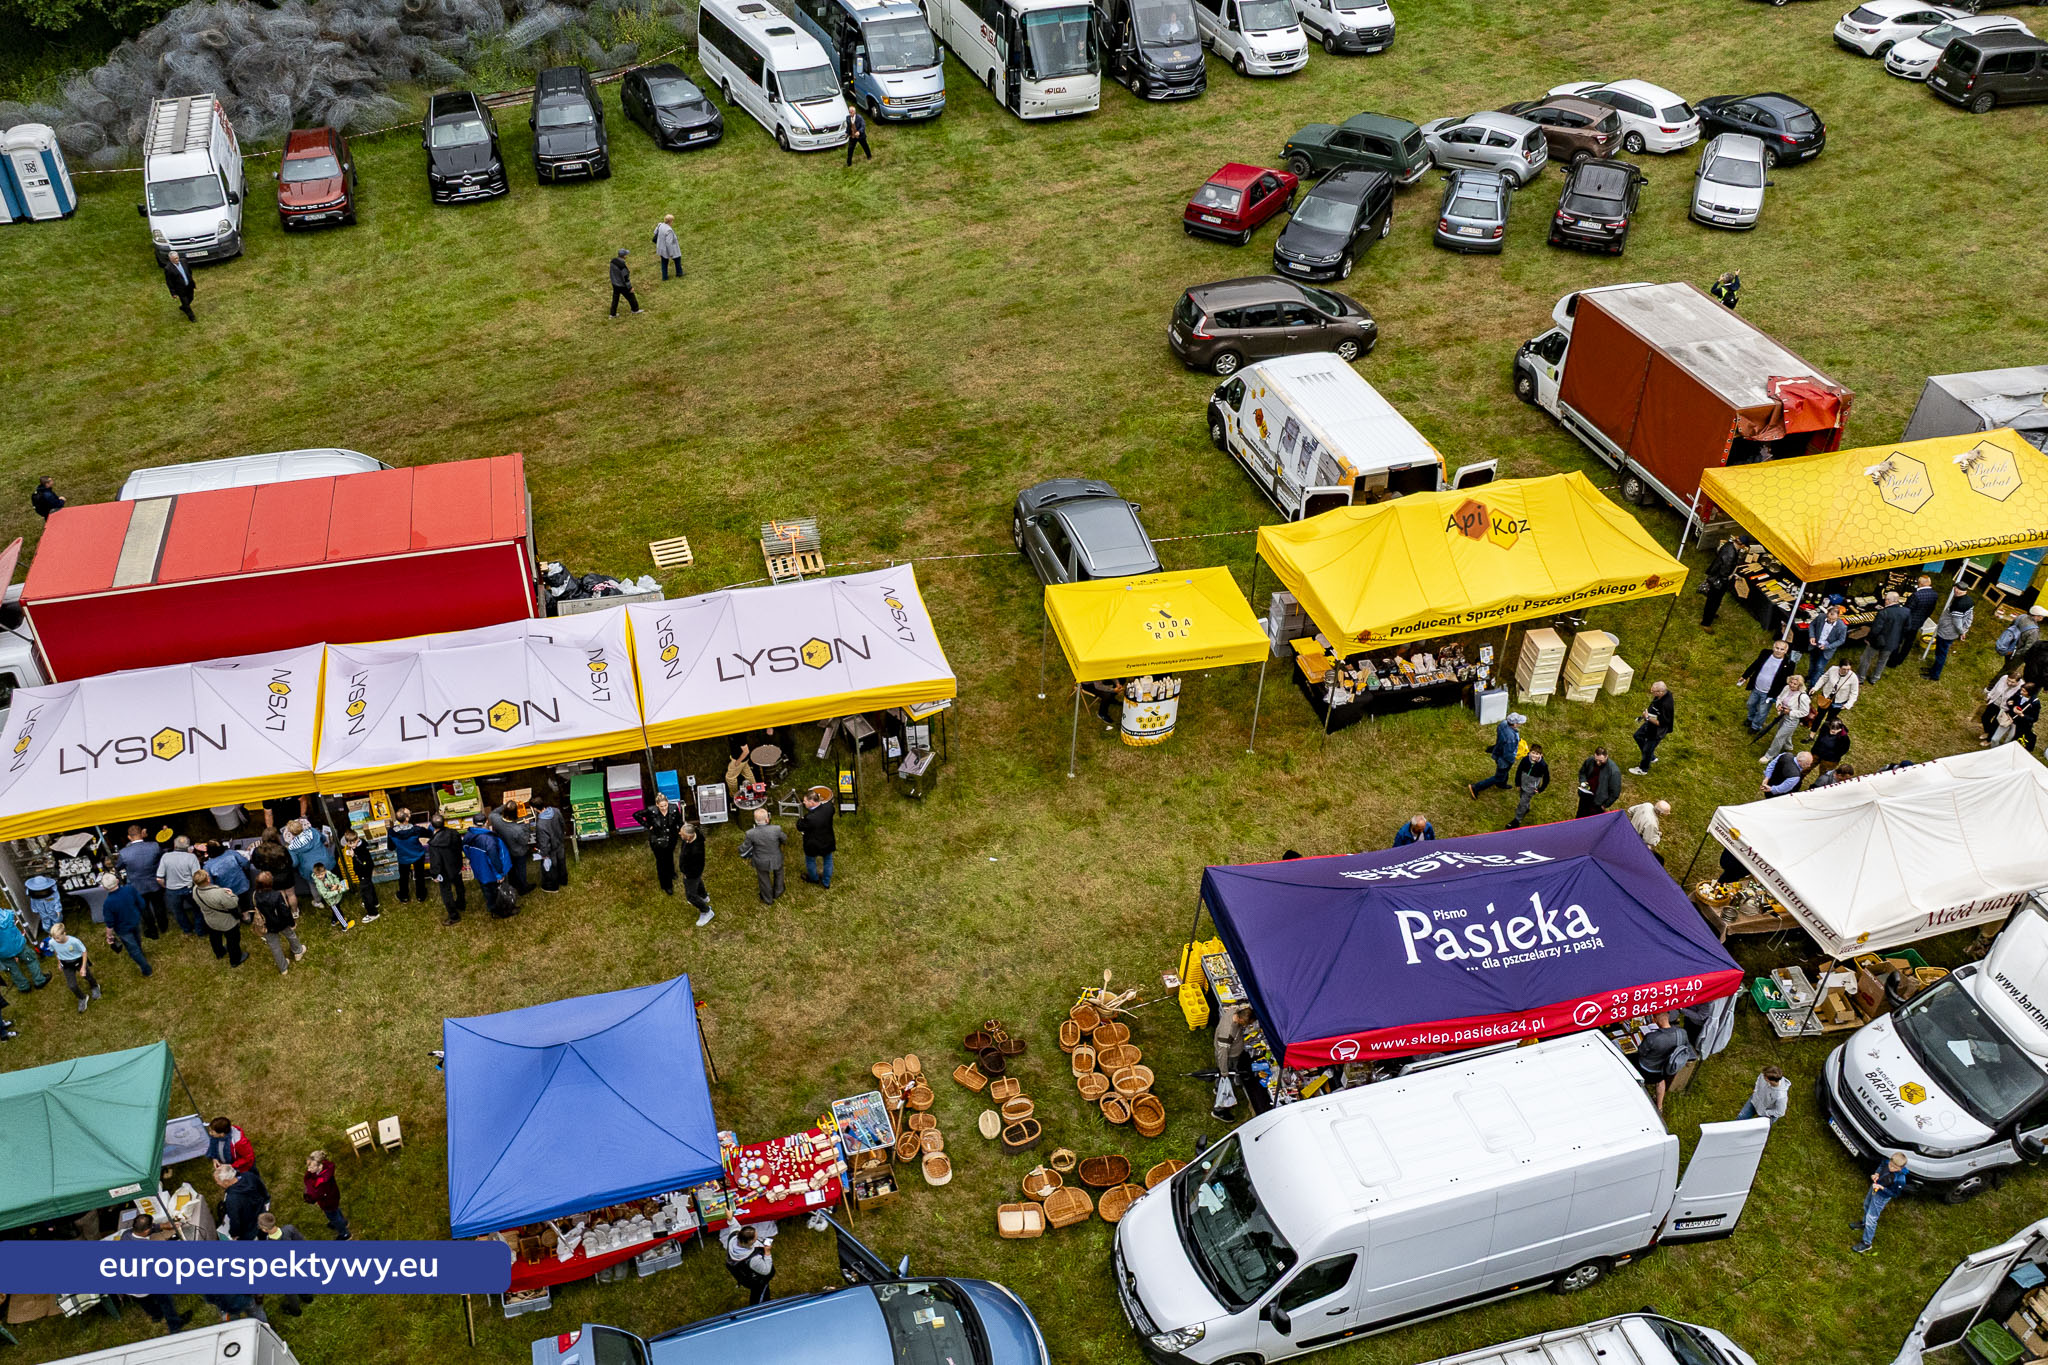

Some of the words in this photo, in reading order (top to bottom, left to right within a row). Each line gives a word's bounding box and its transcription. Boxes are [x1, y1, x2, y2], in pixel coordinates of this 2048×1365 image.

[2027, 528, 2048, 542] BA
[1146, 618, 1191, 631] SUDA
[1390, 614, 1462, 637] Producent
[1466, 604, 1519, 623] Sprzętu
[1523, 583, 1637, 610] Pszczelarskiego
[1154, 629, 1187, 640] ROL
[716, 635, 871, 682] LYSON
[400, 697, 561, 742] LYSON
[1138, 713, 1169, 723] SUDA
[59, 724, 228, 775] LYSON
[1345, 850, 1555, 881] Pasieka
[1433, 908, 1468, 920] Pismo
[1774, 877, 1812, 918] natury
[1394, 891, 1600, 965] Pasieka
[1914, 899, 1976, 933] Miód
[1482, 957, 1501, 970] dla
[1503, 946, 1561, 968] pszczelarzy
[1564, 945, 1572, 954] z
[1573, 936, 1605, 955] pasją
[1611, 992, 1629, 1006] 33
[1633, 979, 1703, 1001] 873-51-40
[1610, 1006, 1627, 1020] 33
[1371, 1017, 1545, 1051] www.sklep.pasieka24.pl
[1857, 1086, 1888, 1122] IVECO
[1865, 1071, 1905, 1110] BARTNIK
